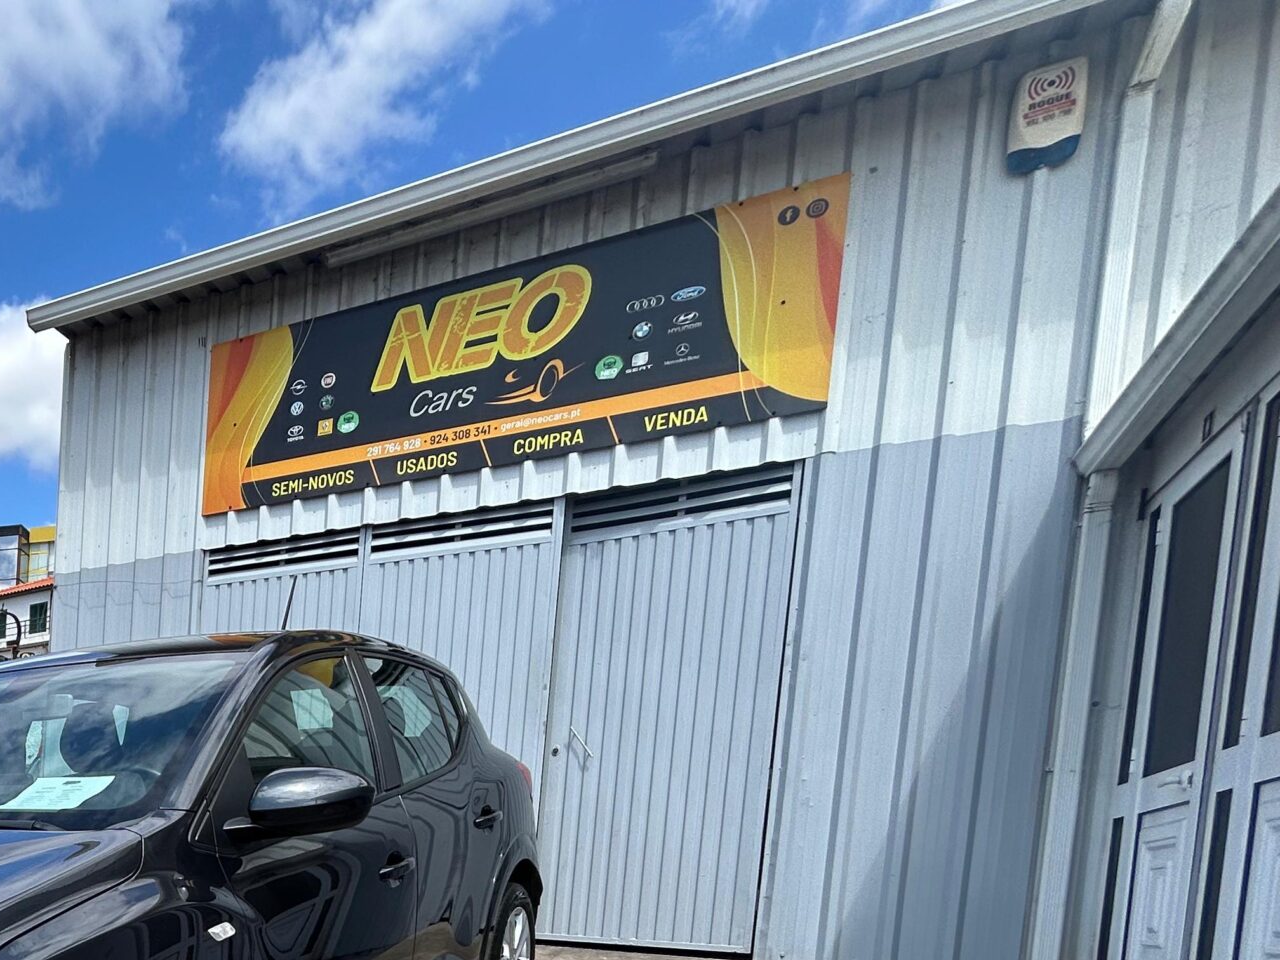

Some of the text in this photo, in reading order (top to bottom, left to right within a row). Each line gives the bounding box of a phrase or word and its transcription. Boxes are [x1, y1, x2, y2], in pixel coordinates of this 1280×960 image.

[370, 264, 592, 392] NEO
[625, 363, 654, 374] SEAT
[409, 385, 477, 417] Cars
[367, 408, 581, 457] 291 764 928 924 308 341 geral@neocars.pt
[643, 405, 709, 433] VENDA
[513, 428, 584, 455] COMPRA
[396, 451, 458, 476] USADOS
[271, 470, 355, 497] SEMI-NOVOS
